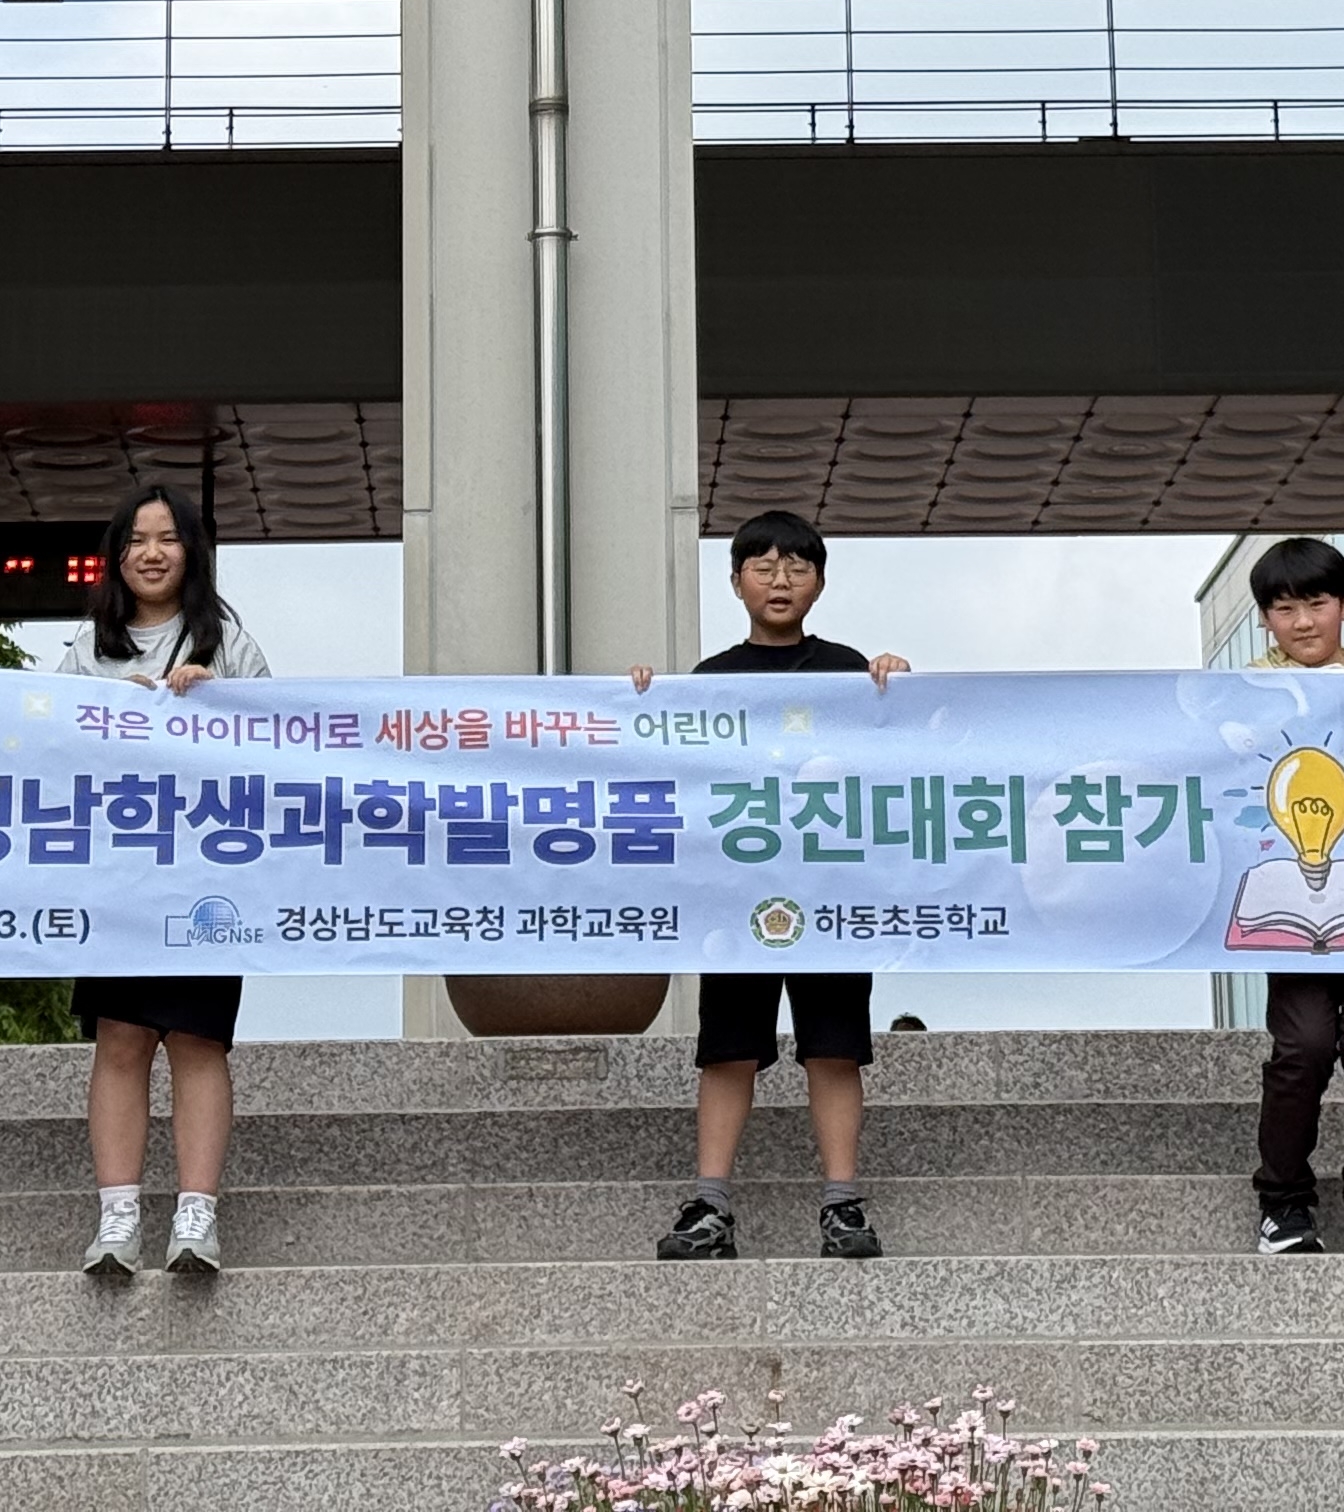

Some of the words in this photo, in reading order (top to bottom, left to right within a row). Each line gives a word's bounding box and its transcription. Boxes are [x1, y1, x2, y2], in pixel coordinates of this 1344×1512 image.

[75, 703, 154, 742] 작은
[165, 710, 364, 751] 아이디어로
[374, 707, 493, 753] 세상을
[505, 708, 622, 748] 바꾸는
[633, 708, 749, 747] 어린이
[706, 774, 1028, 865] 경진대회
[1052, 774, 1215, 865] 참가
[275, 904, 505, 943] 경상남도교육청
[515, 904, 680, 943] 과학교육원
[812, 902, 1011, 941] 하동초등학교
